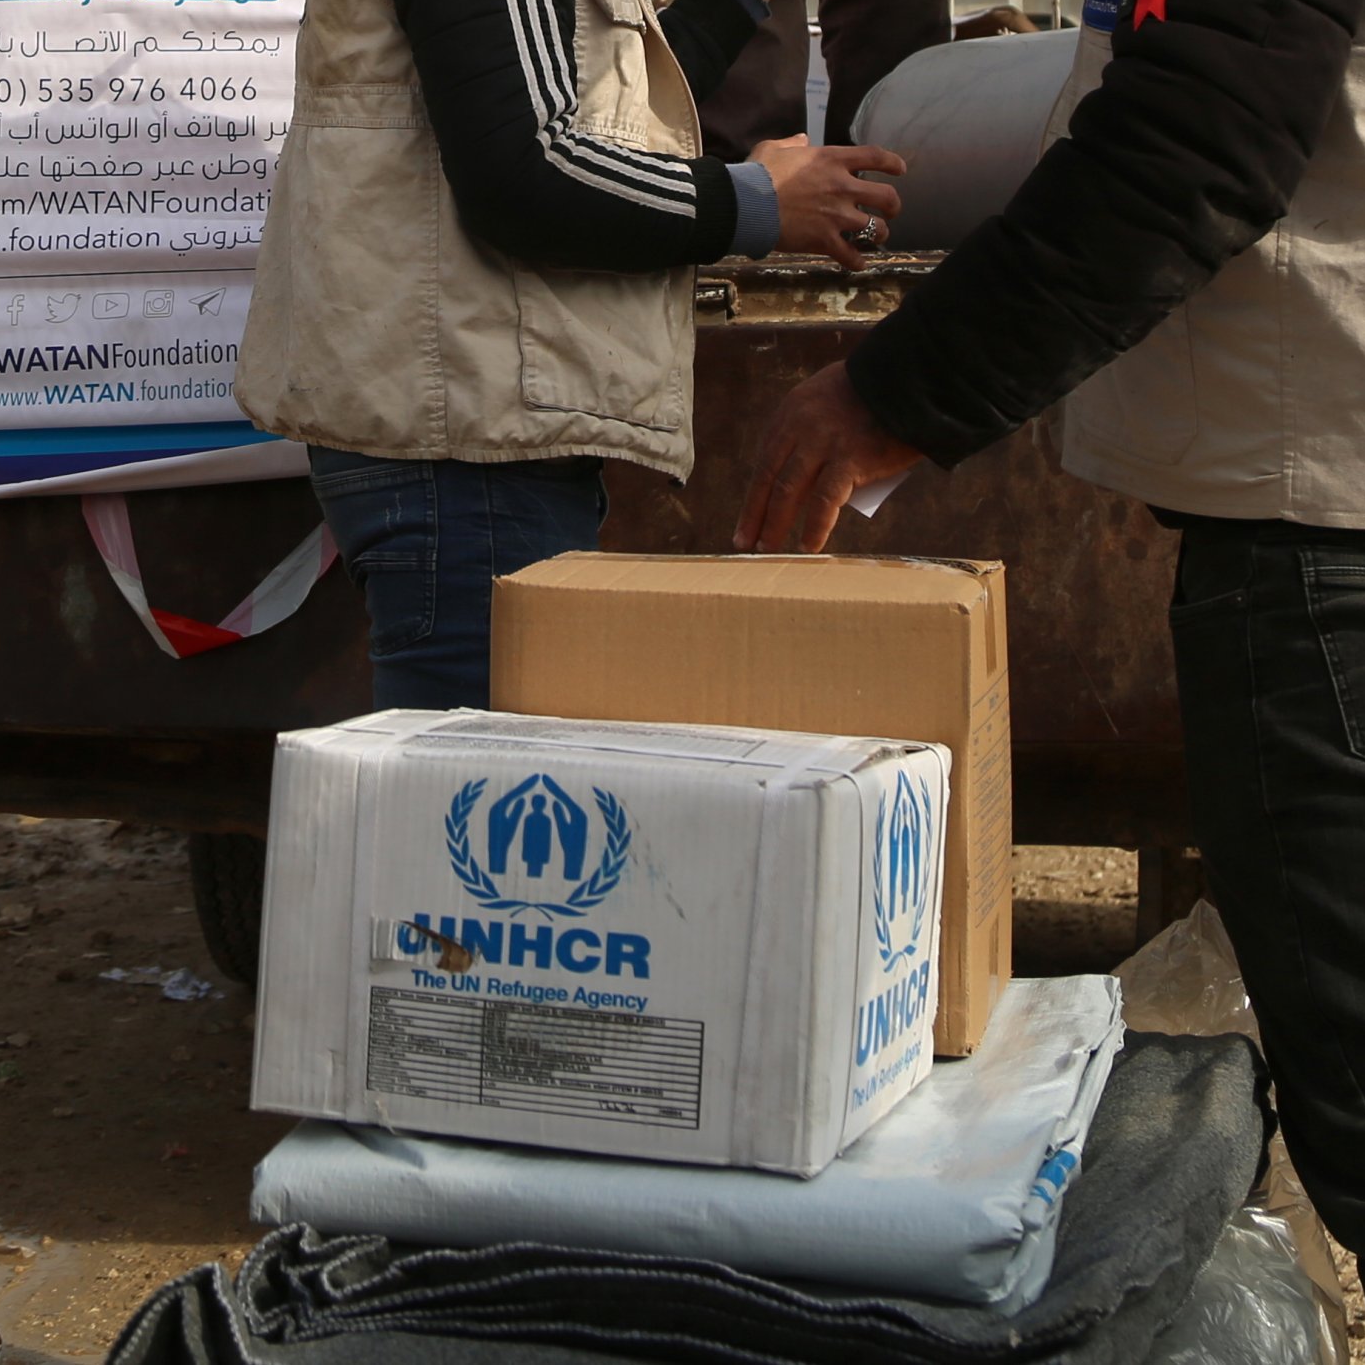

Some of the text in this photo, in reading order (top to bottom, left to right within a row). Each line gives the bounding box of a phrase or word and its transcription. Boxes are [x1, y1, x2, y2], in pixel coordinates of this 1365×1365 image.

[21, 31, 126, 58] الاتصال
[134, 31, 280, 57] يمكنكم
[38, 78, 94, 103] 535
[109, 78, 166, 103] 976
[180, 76, 257, 101] 4066
[9, 112, 39, 145] أب
[45, 116, 137, 144] الواتس
[147, 111, 168, 143] أو
[174, 115, 255, 142] الهاتف
[40, 155, 143, 182] صفحتها
[151, 160, 194, 182] عبر
[202, 153, 267, 180] وطن
[397, 913, 651, 979] UNHCR
[411, 969, 446, 988] The
[452, 975, 481, 992] UN
[487, 978, 569, 1002] Refugee
[573, 987, 648, 1012] Agency
[856, 960, 930, 1067] UNHCR
